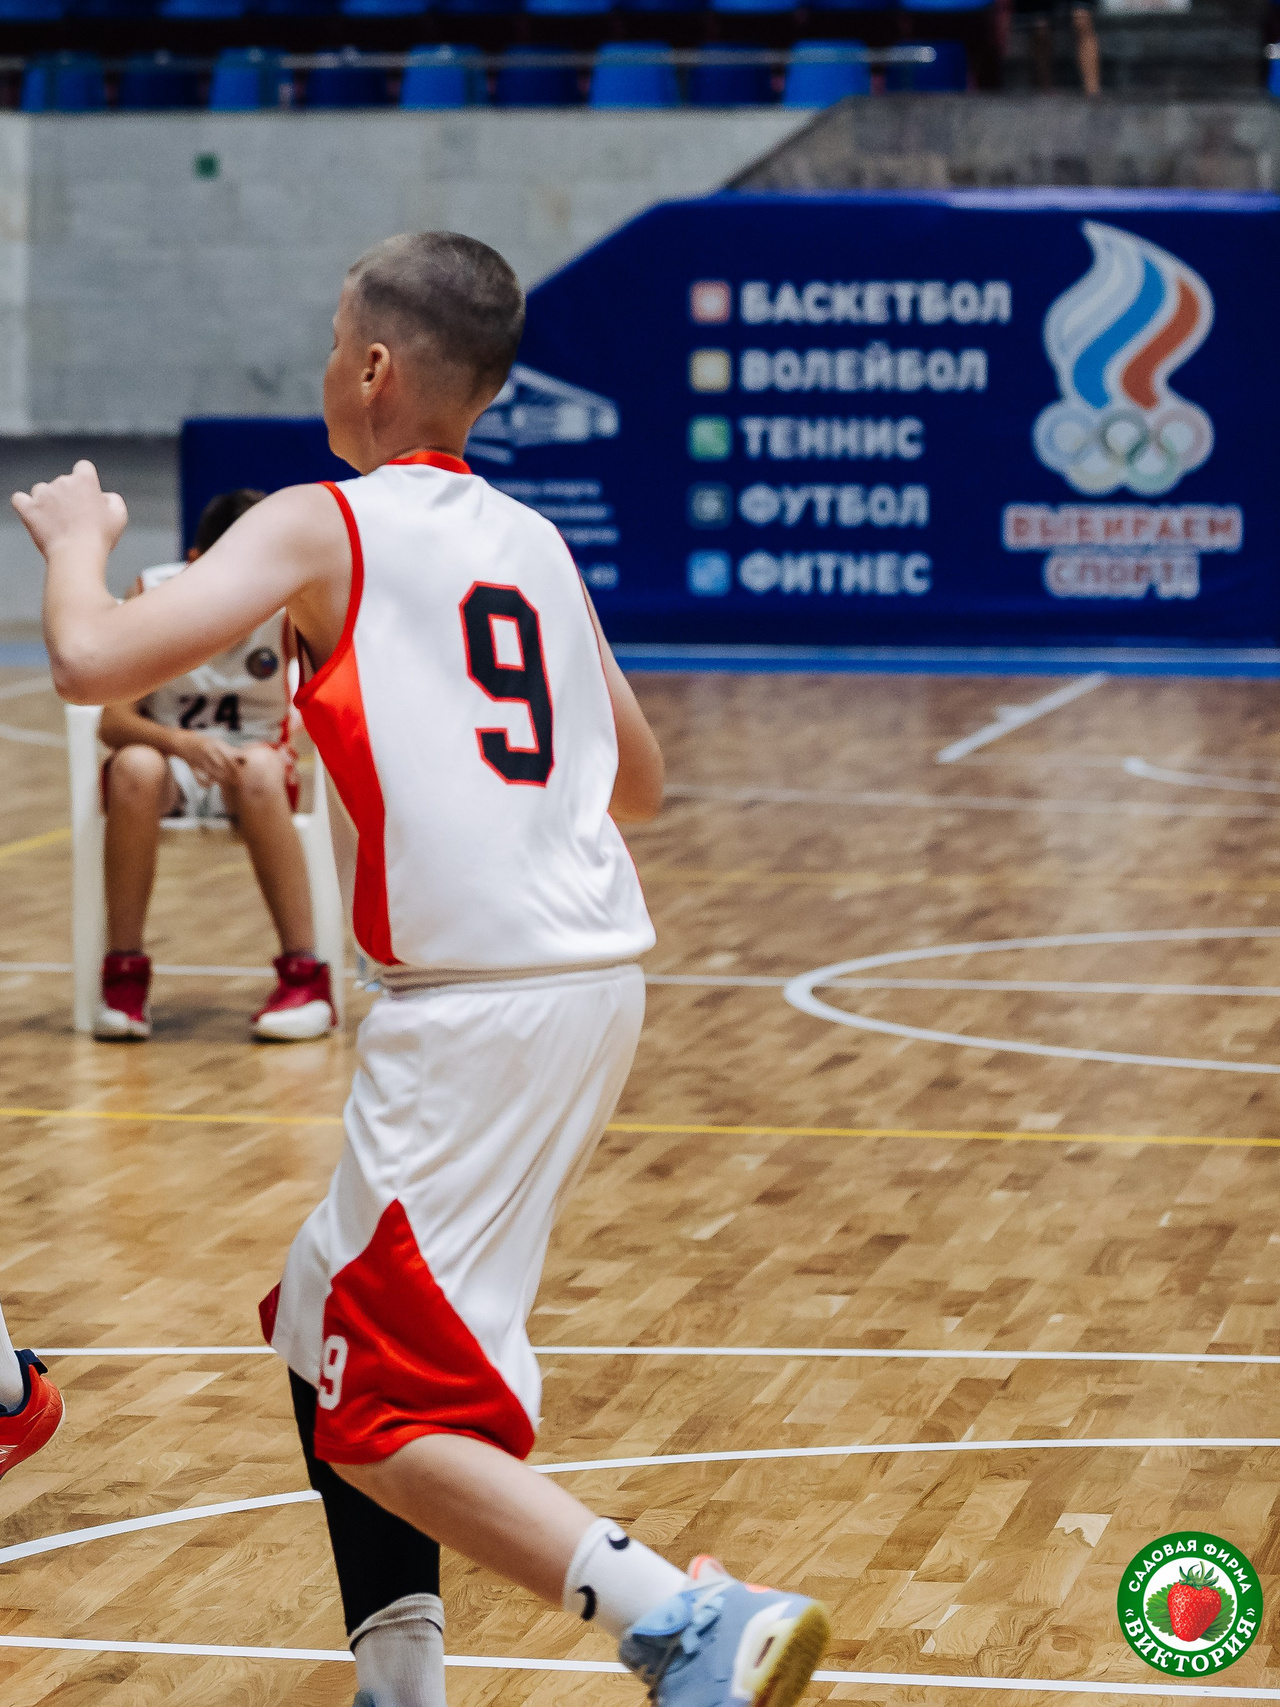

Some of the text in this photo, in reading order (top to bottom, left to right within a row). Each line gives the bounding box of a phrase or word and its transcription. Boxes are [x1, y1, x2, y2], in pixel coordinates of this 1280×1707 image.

[740, 281, 1011, 324] БАСКЕТБОЛ
[740, 342, 988, 391] ВОЛЕЙБОЛ
[739, 418, 925, 459] ТЕННИС
[739, 484, 929, 526] ФУТБОЛ
[1005, 506, 1240, 547] ВЫБИРАЕМ
[739, 552, 931, 594] ФИТНЕС
[458, 580, 555, 788] 9
[176, 691, 242, 732] 24
[318, 1334, 349, 1411] 9
